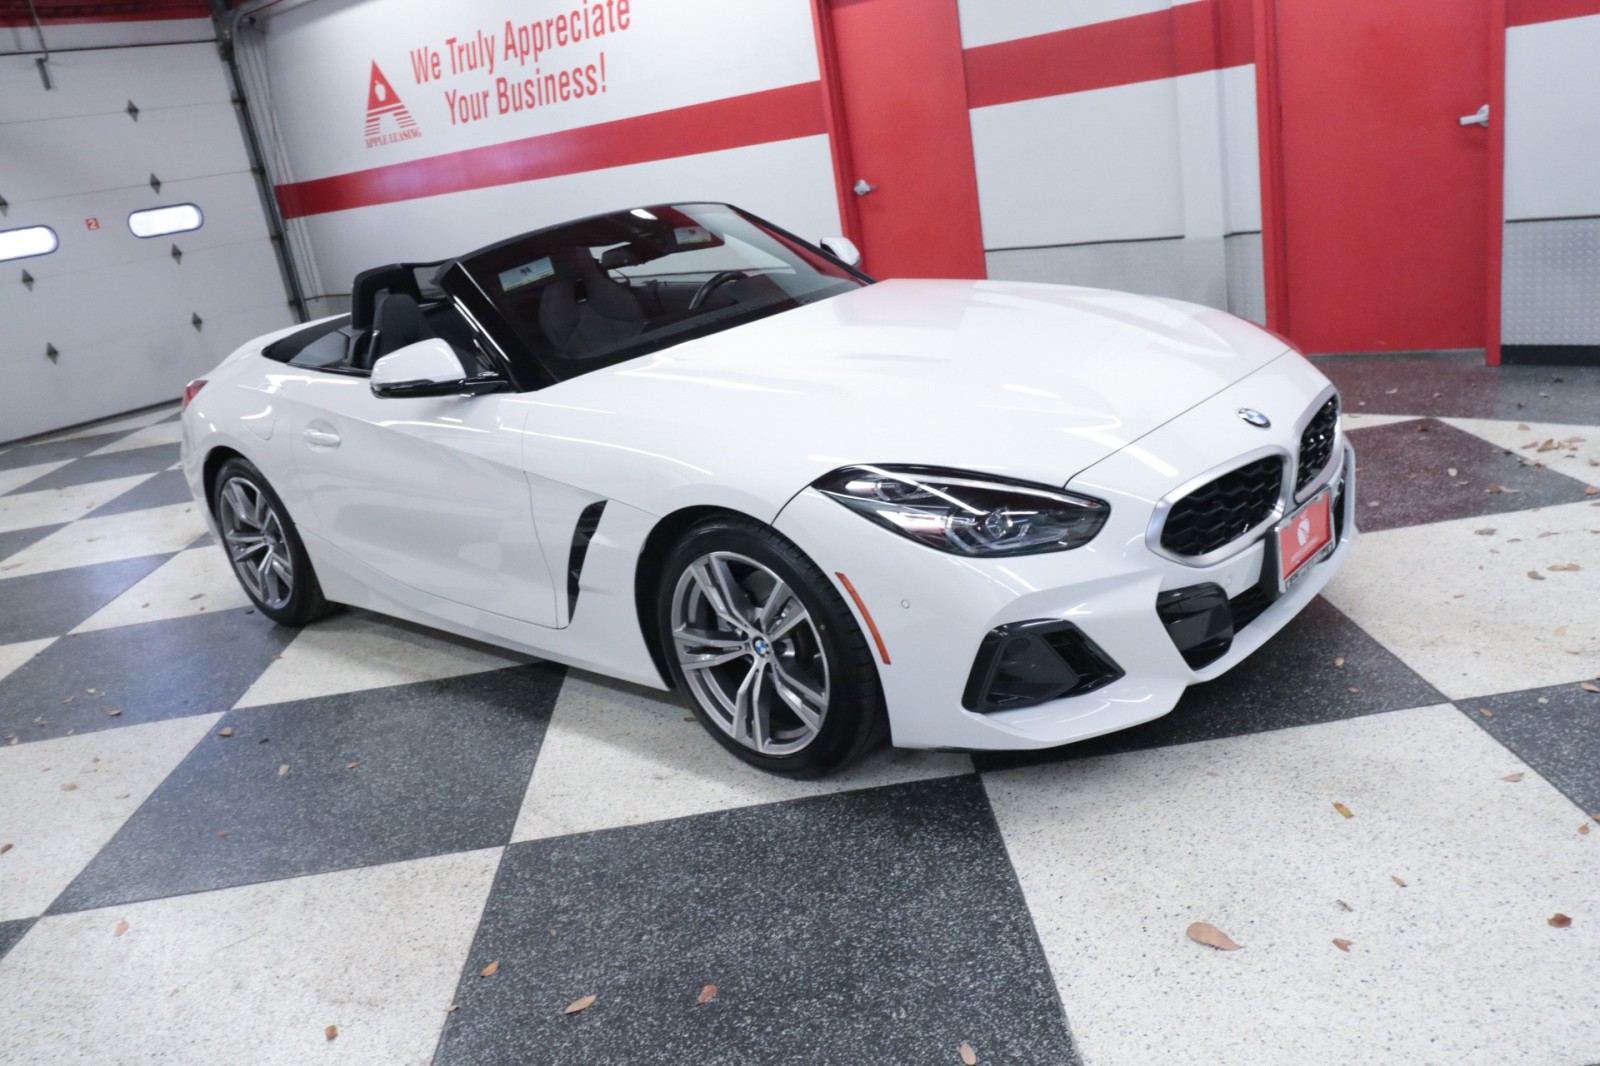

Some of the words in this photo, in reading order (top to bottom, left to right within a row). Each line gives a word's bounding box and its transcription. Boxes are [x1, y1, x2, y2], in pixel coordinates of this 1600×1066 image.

[410, 46, 441, 85] We
[445, 30, 495, 75] Truly
[504, 0, 630, 66] Appreciate
[445, 88, 489, 125] Your
[496, 52, 606, 115] Business!
[365, 134, 388, 149] APPLE
[388, 127, 422, 144] LEASING
